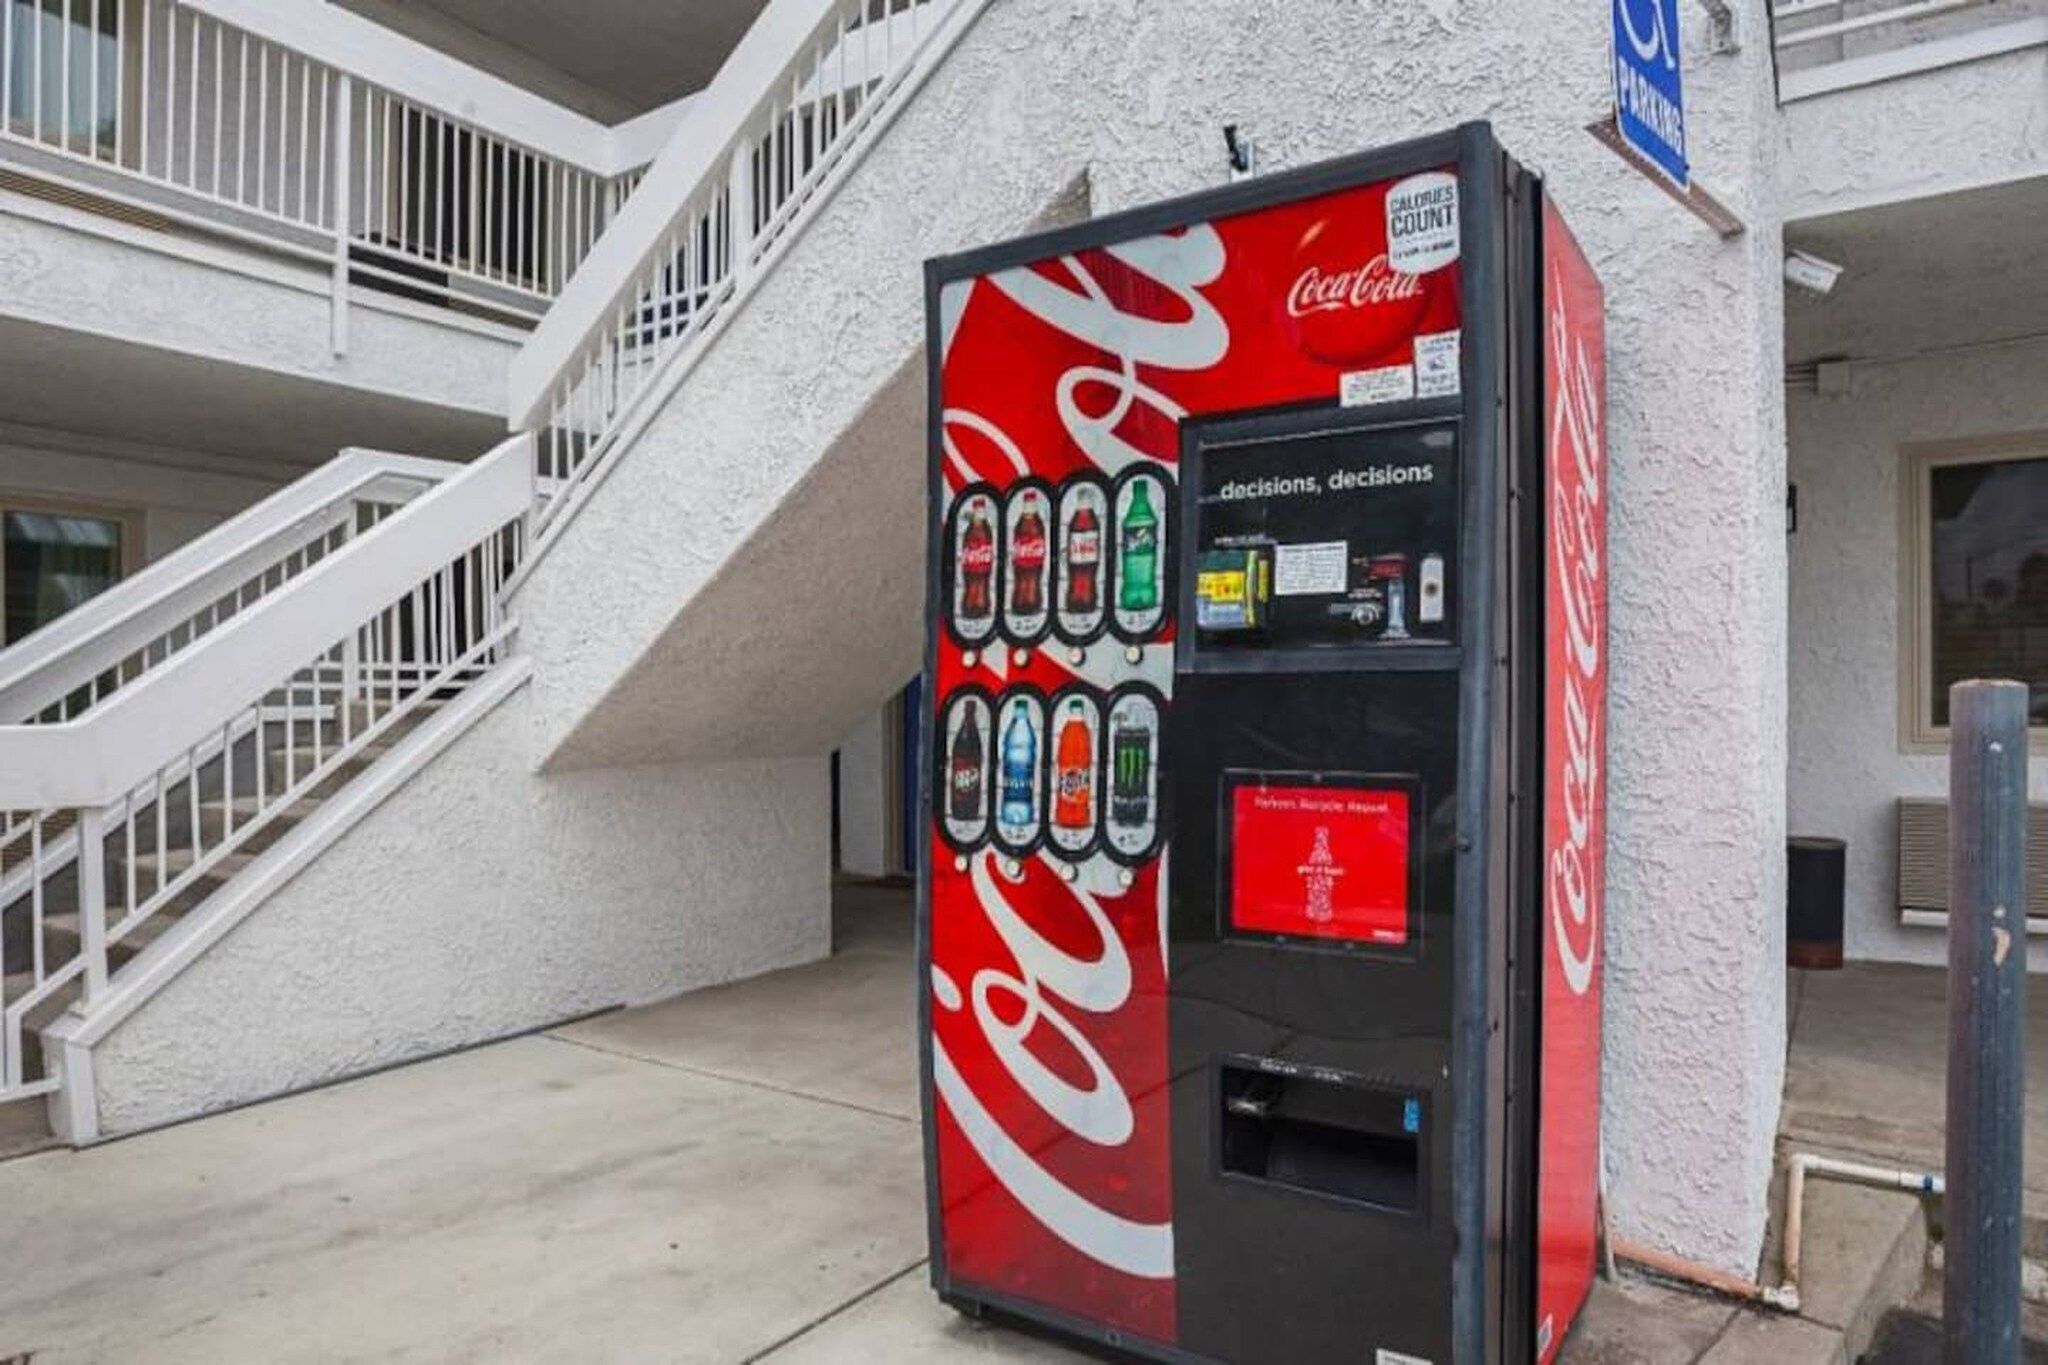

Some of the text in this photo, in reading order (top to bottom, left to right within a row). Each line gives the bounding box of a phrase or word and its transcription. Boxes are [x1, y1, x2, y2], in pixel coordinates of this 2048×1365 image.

[1618, 54, 1684, 157] PARKING
[1391, 185, 1454, 215] CALORIES
[1391, 203, 1453, 239] COUNT
[1220, 463, 1434, 500] decisions, decisions
